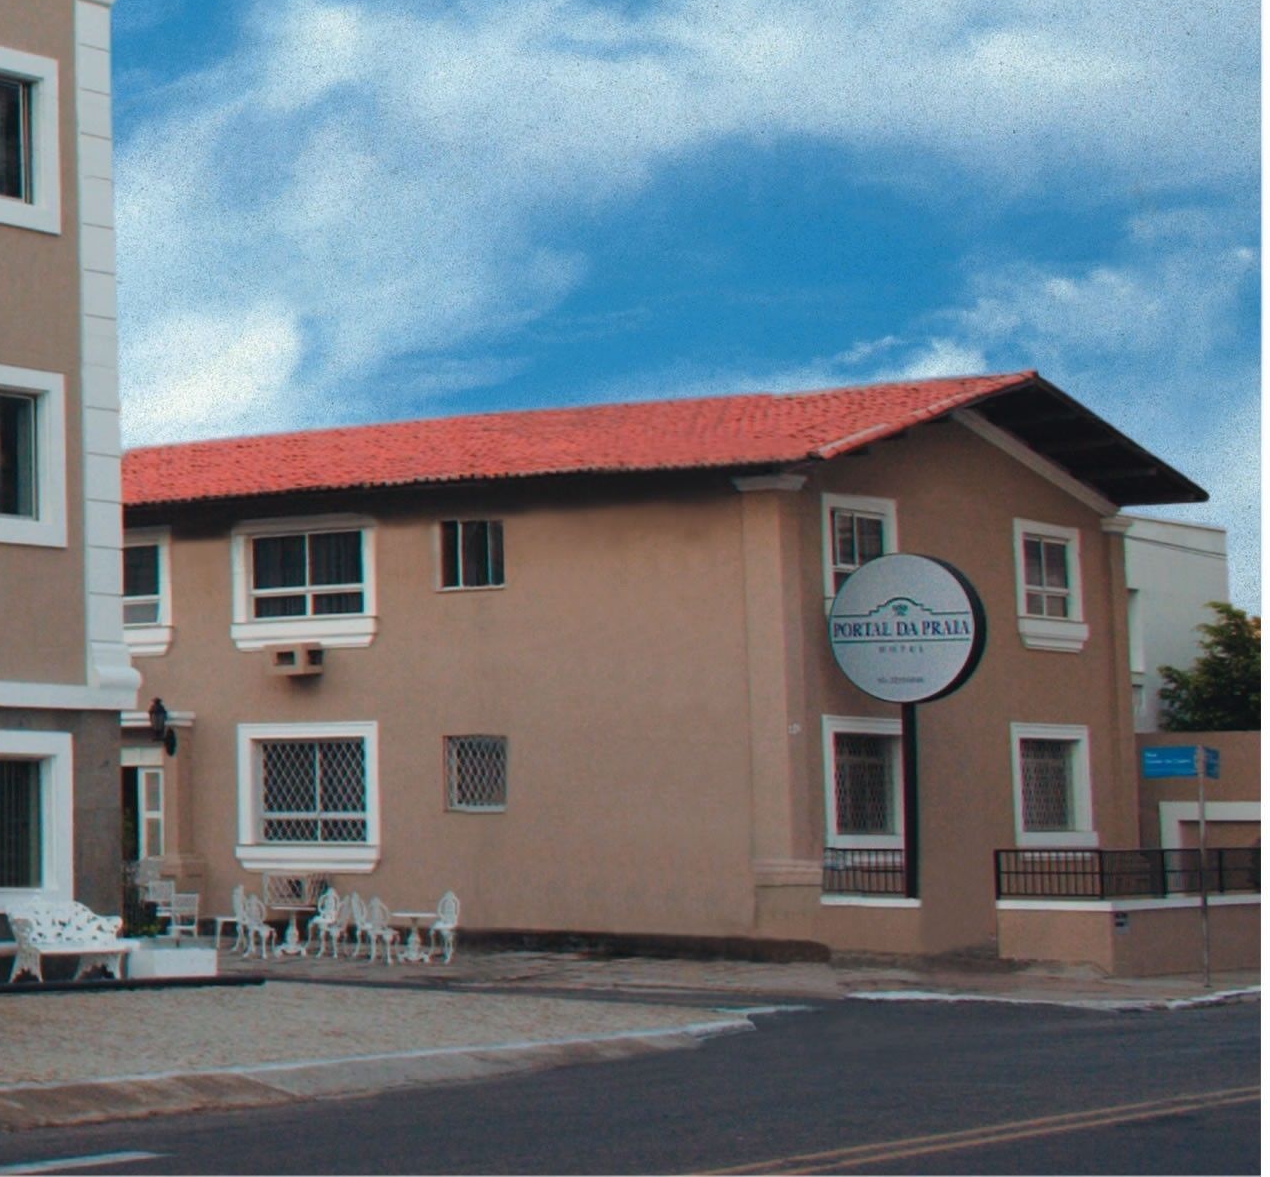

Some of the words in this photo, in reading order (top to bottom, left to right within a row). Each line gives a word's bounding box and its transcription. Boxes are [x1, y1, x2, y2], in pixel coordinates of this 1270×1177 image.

[833, 622, 892, 638] PORTAL
[896, 621, 918, 637] DA
[922, 620, 971, 635] PRAIA
